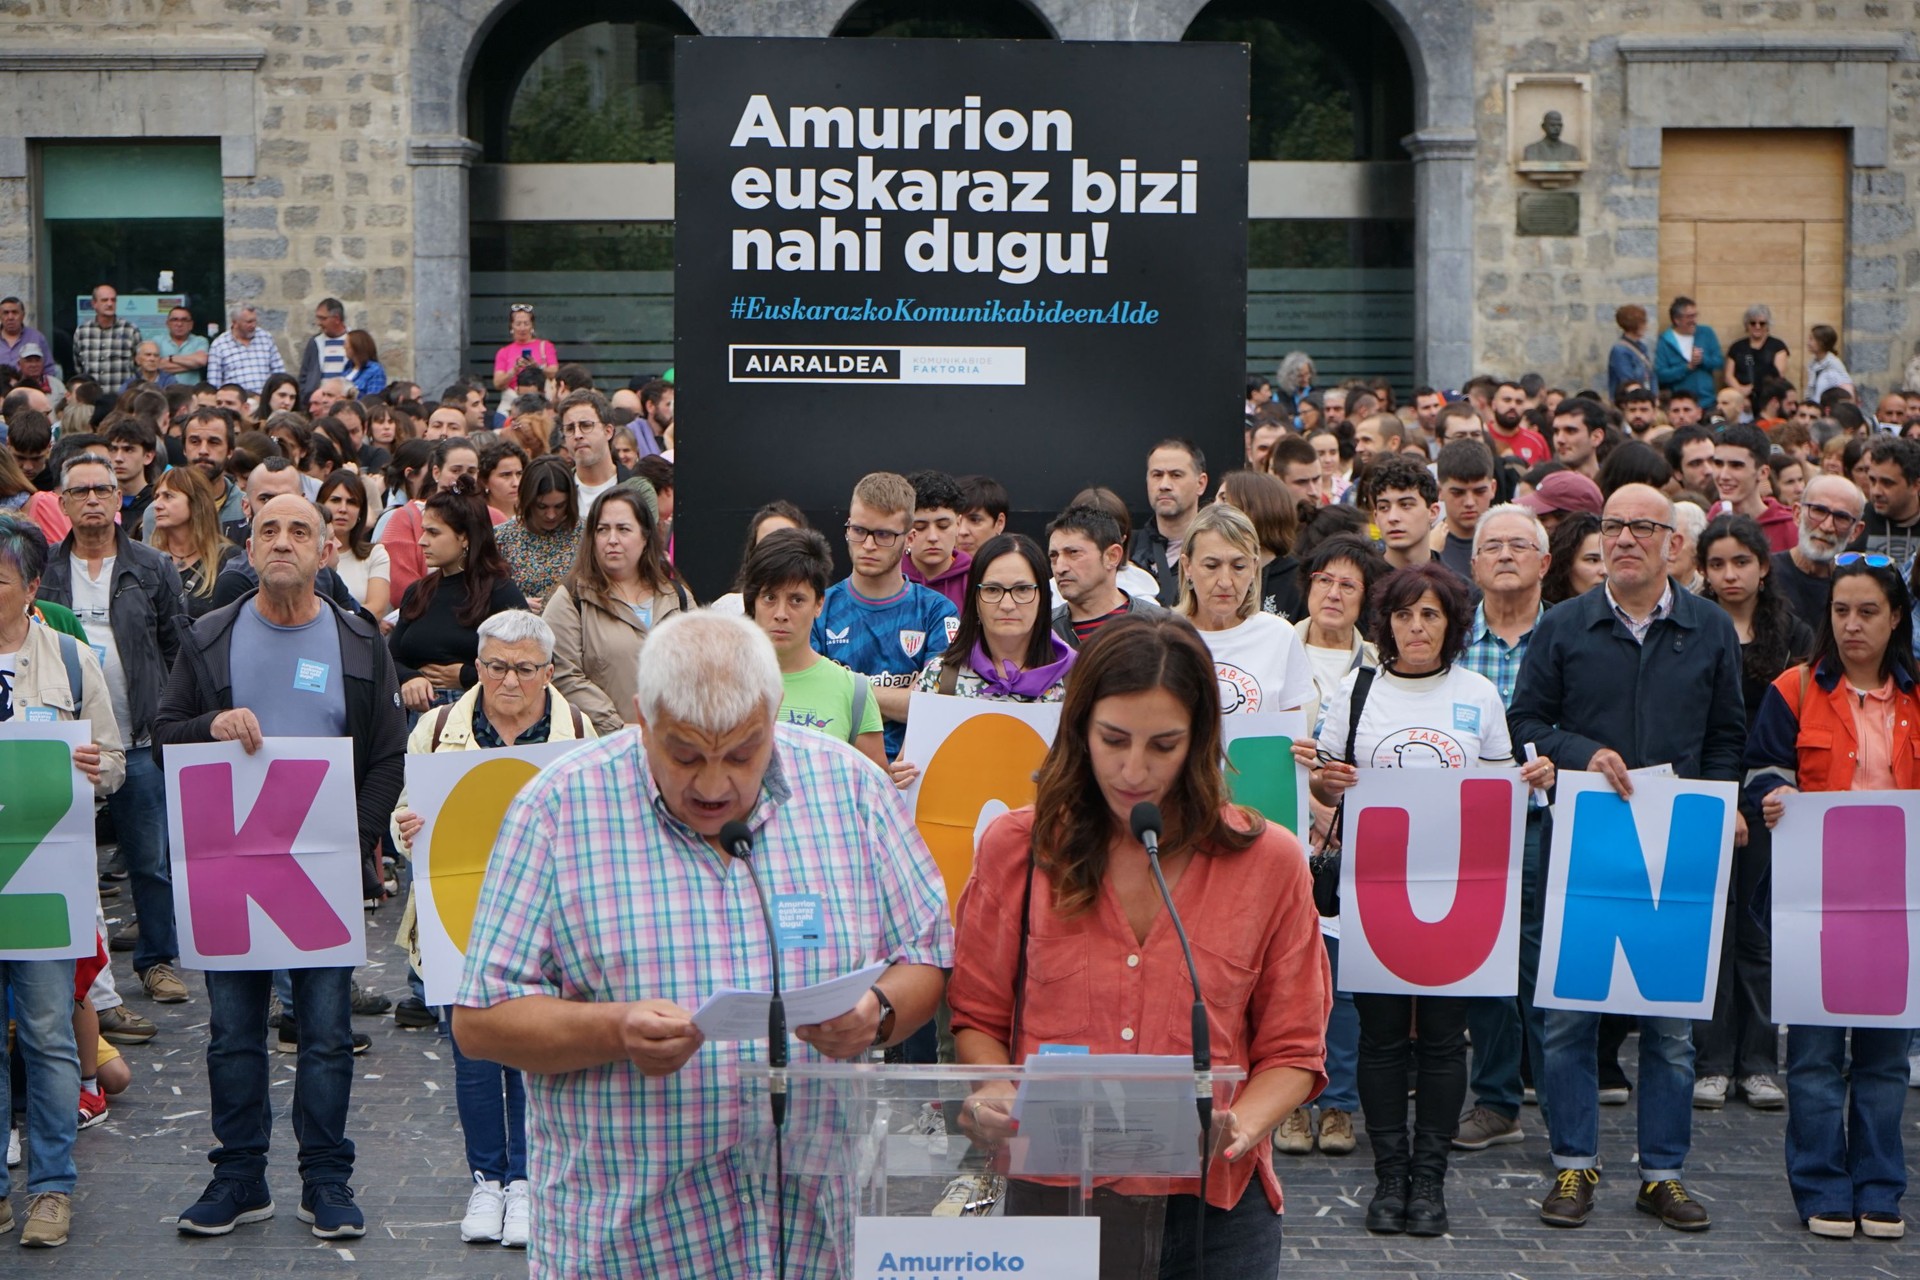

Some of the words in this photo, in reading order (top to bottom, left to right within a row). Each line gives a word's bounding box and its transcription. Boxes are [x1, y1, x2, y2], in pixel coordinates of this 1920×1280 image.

[730, 95, 1073, 151] Amurrion
[731, 156, 1050, 212] euskaraz
[1072, 159, 1198, 214] bizi
[733, 217, 882, 271] nahi
[905, 218, 1110, 284] dugu!
[730, 296, 1159, 325] #EuskarazkoKomunikabideenAlde
[745, 354, 888, 373] AIARALDEA
[913, 356, 993, 365] KOMUNIKABIDE
[913, 365, 981, 374] FAKTORIA
[178, 758, 352, 957] K
[1355, 778, 1513, 987] U
[1552, 790, 1727, 1003] N
[877, 1251, 1025, 1272] Amurrioko
